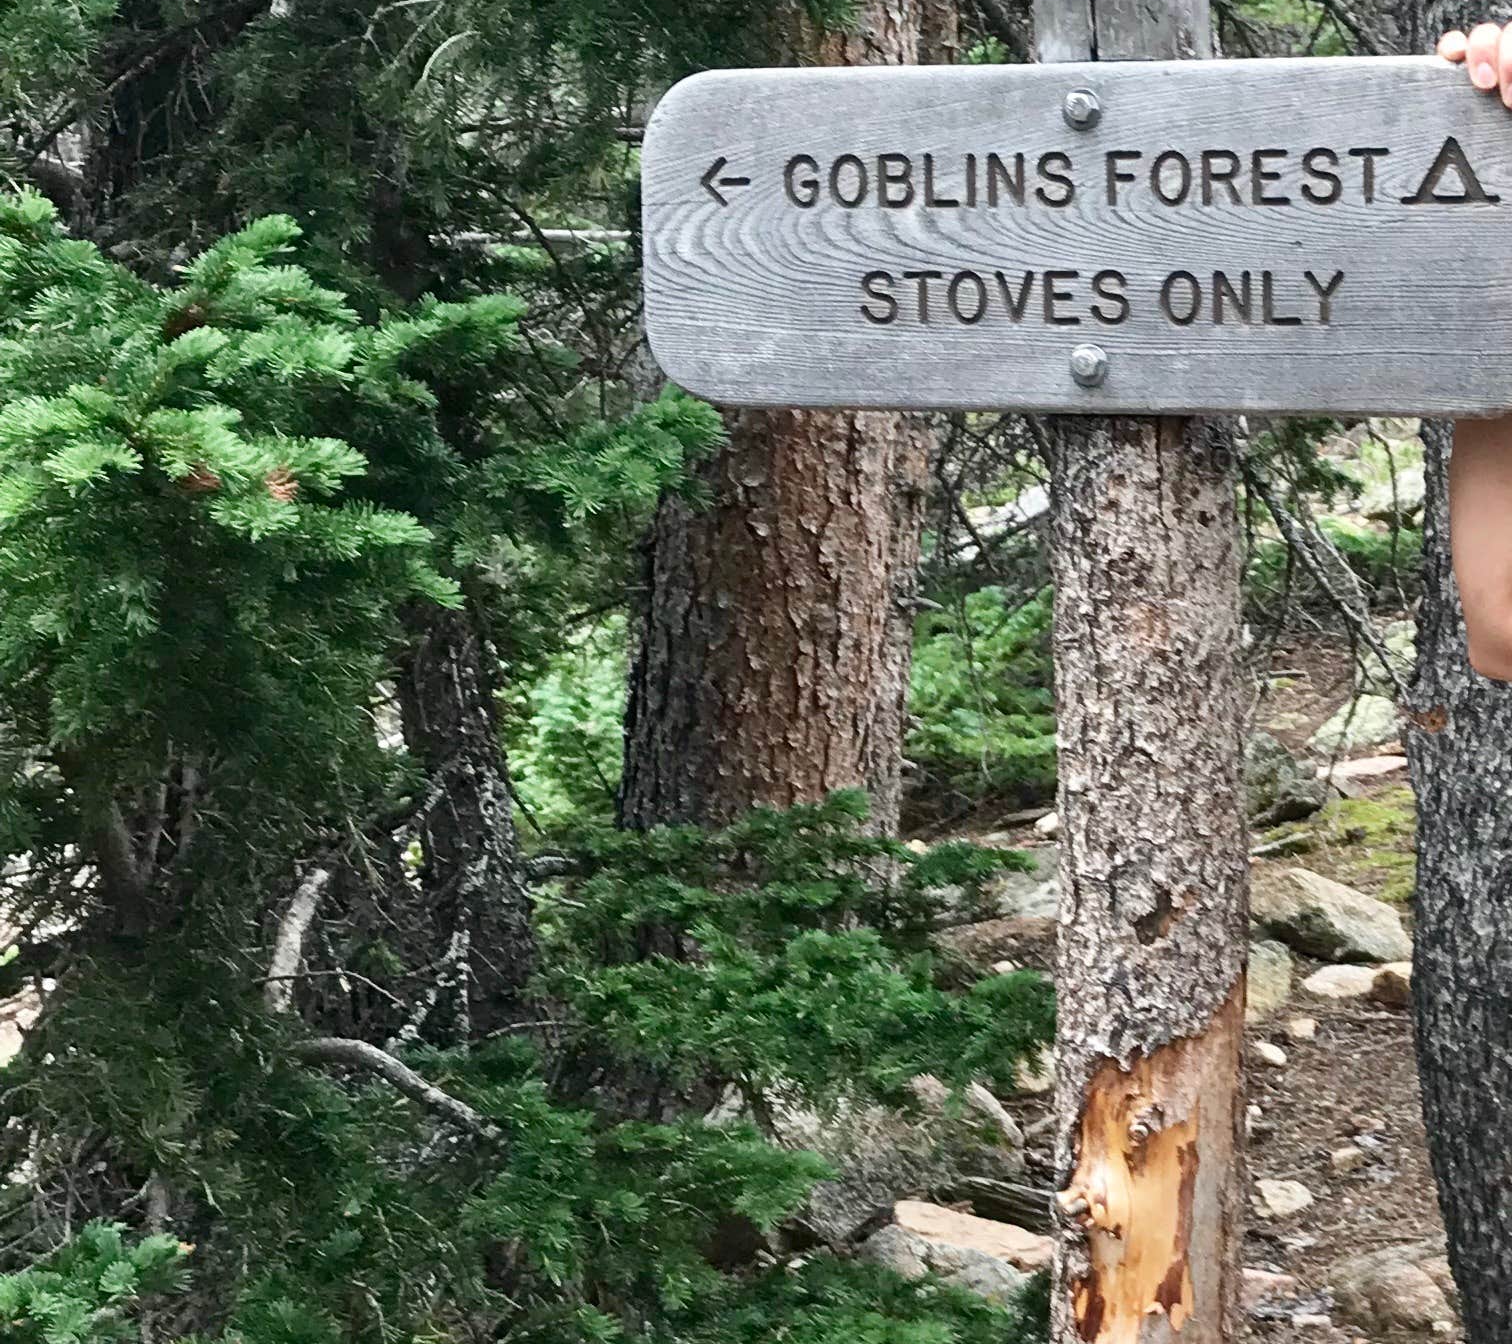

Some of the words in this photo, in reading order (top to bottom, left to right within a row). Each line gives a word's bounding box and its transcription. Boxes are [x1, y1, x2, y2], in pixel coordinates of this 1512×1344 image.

[782, 150, 1076, 209] GOBLINS
[1105, 146, 1390, 208] FOREST
[859, 269, 1130, 327] STOVES
[1159, 268, 1345, 327] ONLY
